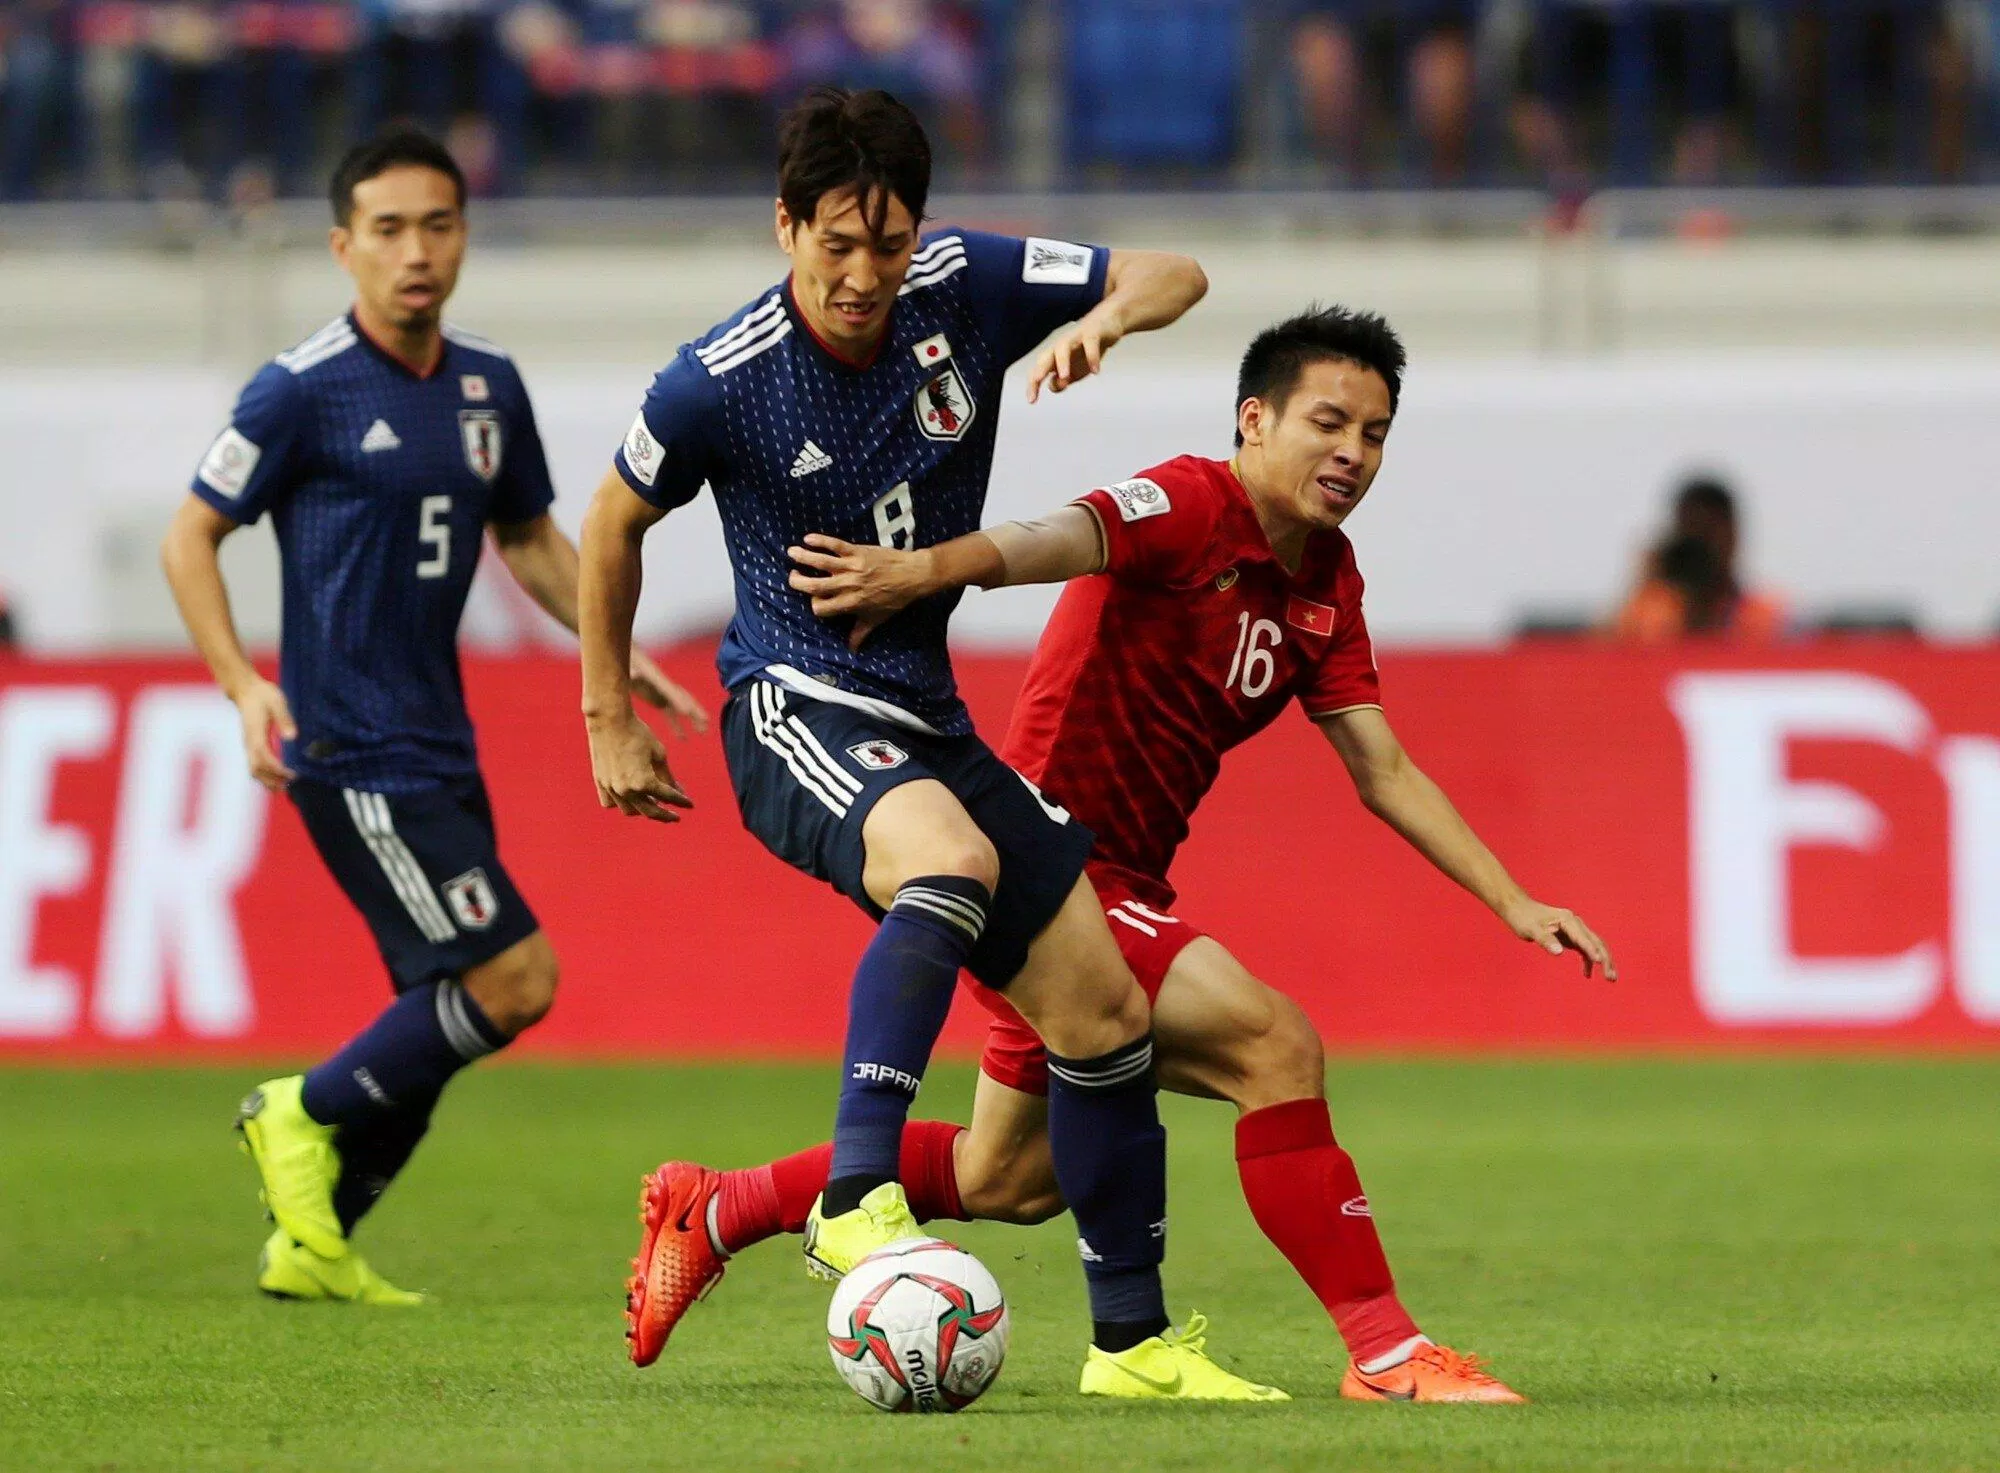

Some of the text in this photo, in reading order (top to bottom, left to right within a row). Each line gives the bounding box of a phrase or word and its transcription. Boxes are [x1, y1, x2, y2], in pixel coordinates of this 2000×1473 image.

[789, 454, 834, 478] adidas
[416, 494, 453, 580] 5
[872, 480, 916, 552] 8
[1225, 611, 1283, 698] 16
[852, 1062, 921, 1096] JAPAN
